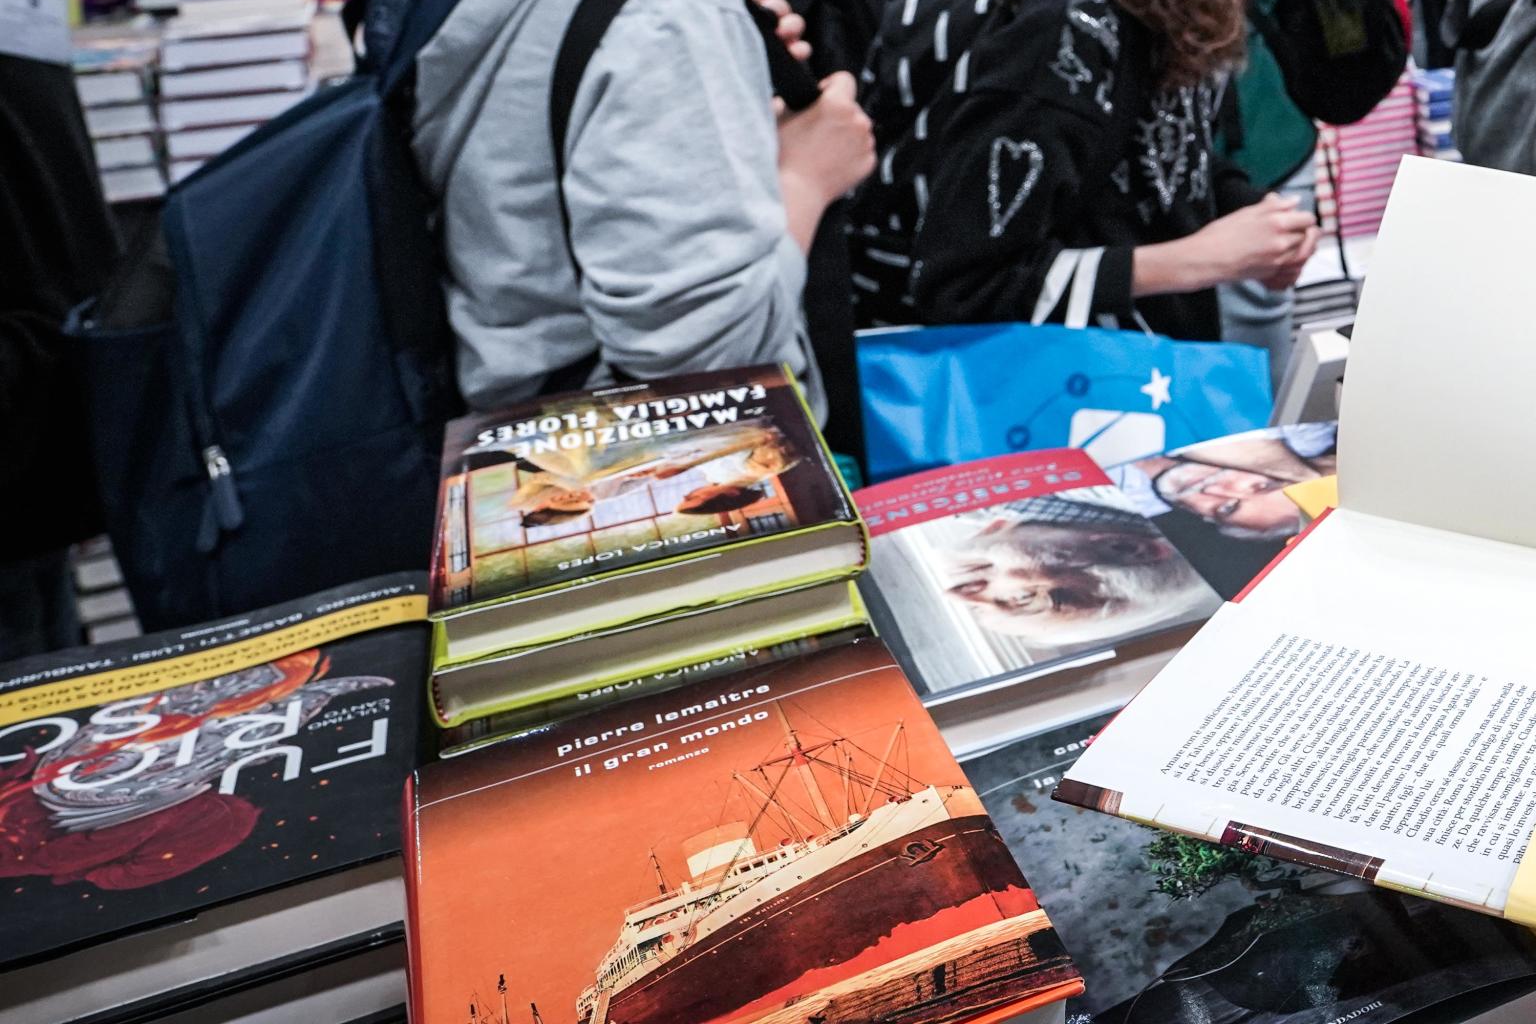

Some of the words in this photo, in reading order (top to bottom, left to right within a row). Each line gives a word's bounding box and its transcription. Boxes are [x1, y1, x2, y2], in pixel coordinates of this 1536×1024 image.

[477, 410, 598, 447] FLORES
[514, 406, 739, 459] MALEDIZIONE
[614, 383, 767, 421] FAMIGLIA
[864, 478, 1031, 526] CRESCENZ
[557, 549, 624, 571] LOPES
[557, 721, 645, 757] pierre
[655, 684, 770, 725] lemaitre
[1160, 749, 1185, 775] Amare
[1182, 735, 1198, 749] non
[1199, 695, 1235, 730] sufficiente,
[1228, 670, 1256, 694] bisogna
[1252, 649, 1273, 670] sapere
[1270, 633, 1288, 650] come
[1240, 774, 1259, 796] poter
[1257, 748, 1280, 774] sentire
[1277, 734, 1291, 748] che
[1289, 723, 1301, 734] sta
[1297, 694, 1324, 722] davvero
[1321, 649, 1360, 694] ricominciando
[1274, 772, 1293, 792] negli
[1290, 756, 1307, 772] altri.
[1302, 726, 1329, 754] Claudio
[1326, 703, 1348, 726] chiede
[1344, 682, 1366, 703] riparo,
[1362, 664, 1378, 681] come
[574, 762, 591, 777] il
[603, 742, 669, 770] gran
[680, 710, 768, 744] mondo
[648, 747, 710, 771] romanzo
[1291, 798, 1307, 810] bri
[1302, 761, 1334, 798] domestici
[1336, 731, 1356, 754] stanno
[1353, 710, 1372, 731] ormai
[1368, 670, 1402, 711] modificando.
[1333, 793, 1359, 820] legami
[1354, 766, 1379, 792] insoliti
[1380, 728, 1406, 759] momenti
[1410, 688, 1436, 718] autentica
[1430, 668, 1448, 687] felici-
[1406, 806, 1432, 838] Claudio
[1429, 787, 1446, 806] cerca
[1448, 756, 1466, 778] stesso
[1468, 731, 1484, 748] casa,
[1486, 698, 1504, 719] anche
[1500, 682, 1514, 699] nella
